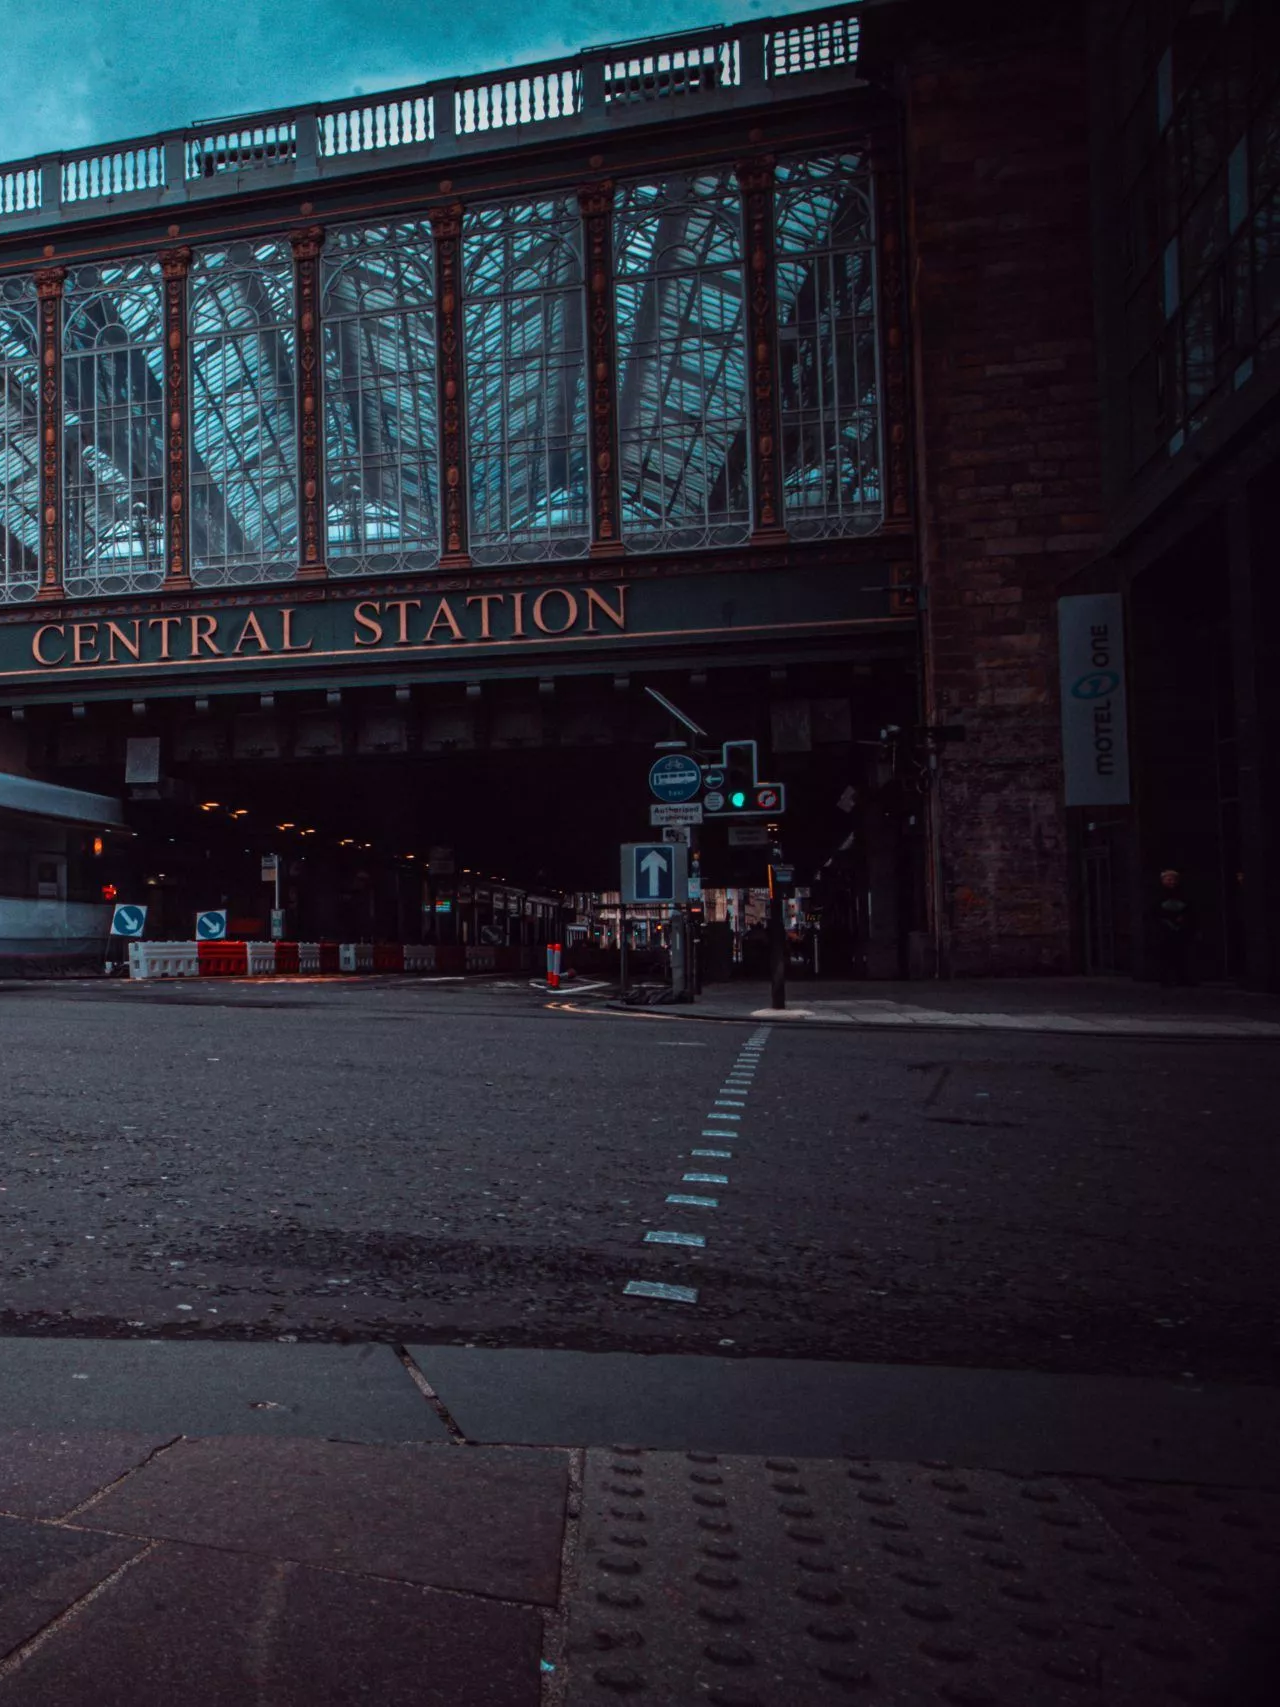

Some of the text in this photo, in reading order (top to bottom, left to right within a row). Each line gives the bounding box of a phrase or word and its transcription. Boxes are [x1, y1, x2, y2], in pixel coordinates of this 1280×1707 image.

[31, 584, 631, 666] CENTRAL STATION
[1091, 624, 1109, 667] ONE
